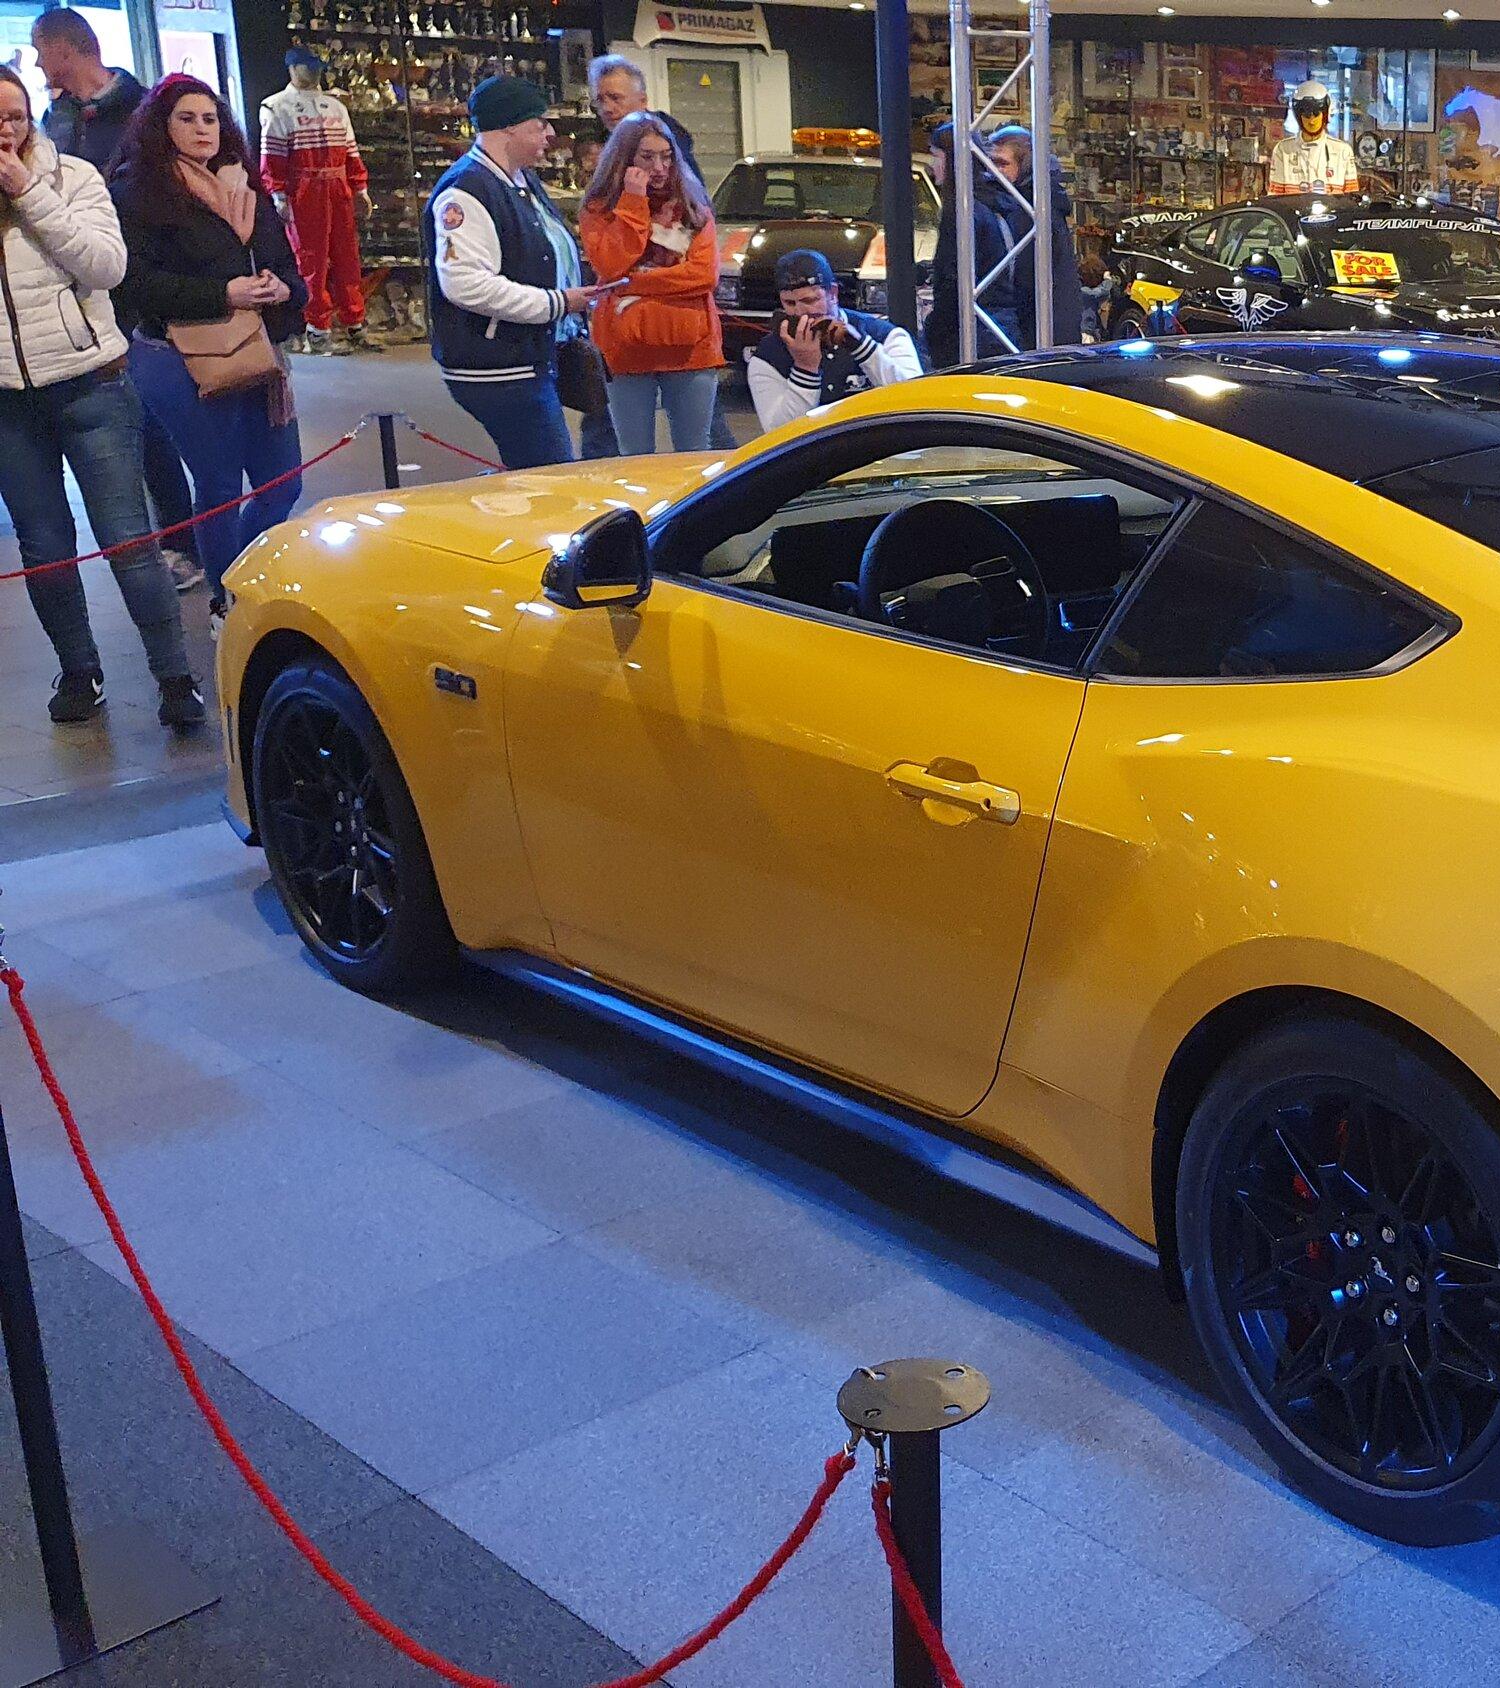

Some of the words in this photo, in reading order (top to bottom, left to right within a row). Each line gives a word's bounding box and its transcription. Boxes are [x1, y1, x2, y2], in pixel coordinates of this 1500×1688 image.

[677, 11, 756, 33] PRIMAGAZ
[1121, 211, 1198, 228] TEAM
[1344, 252, 1387, 266] FOR
[1342, 265, 1392, 276] SALE
